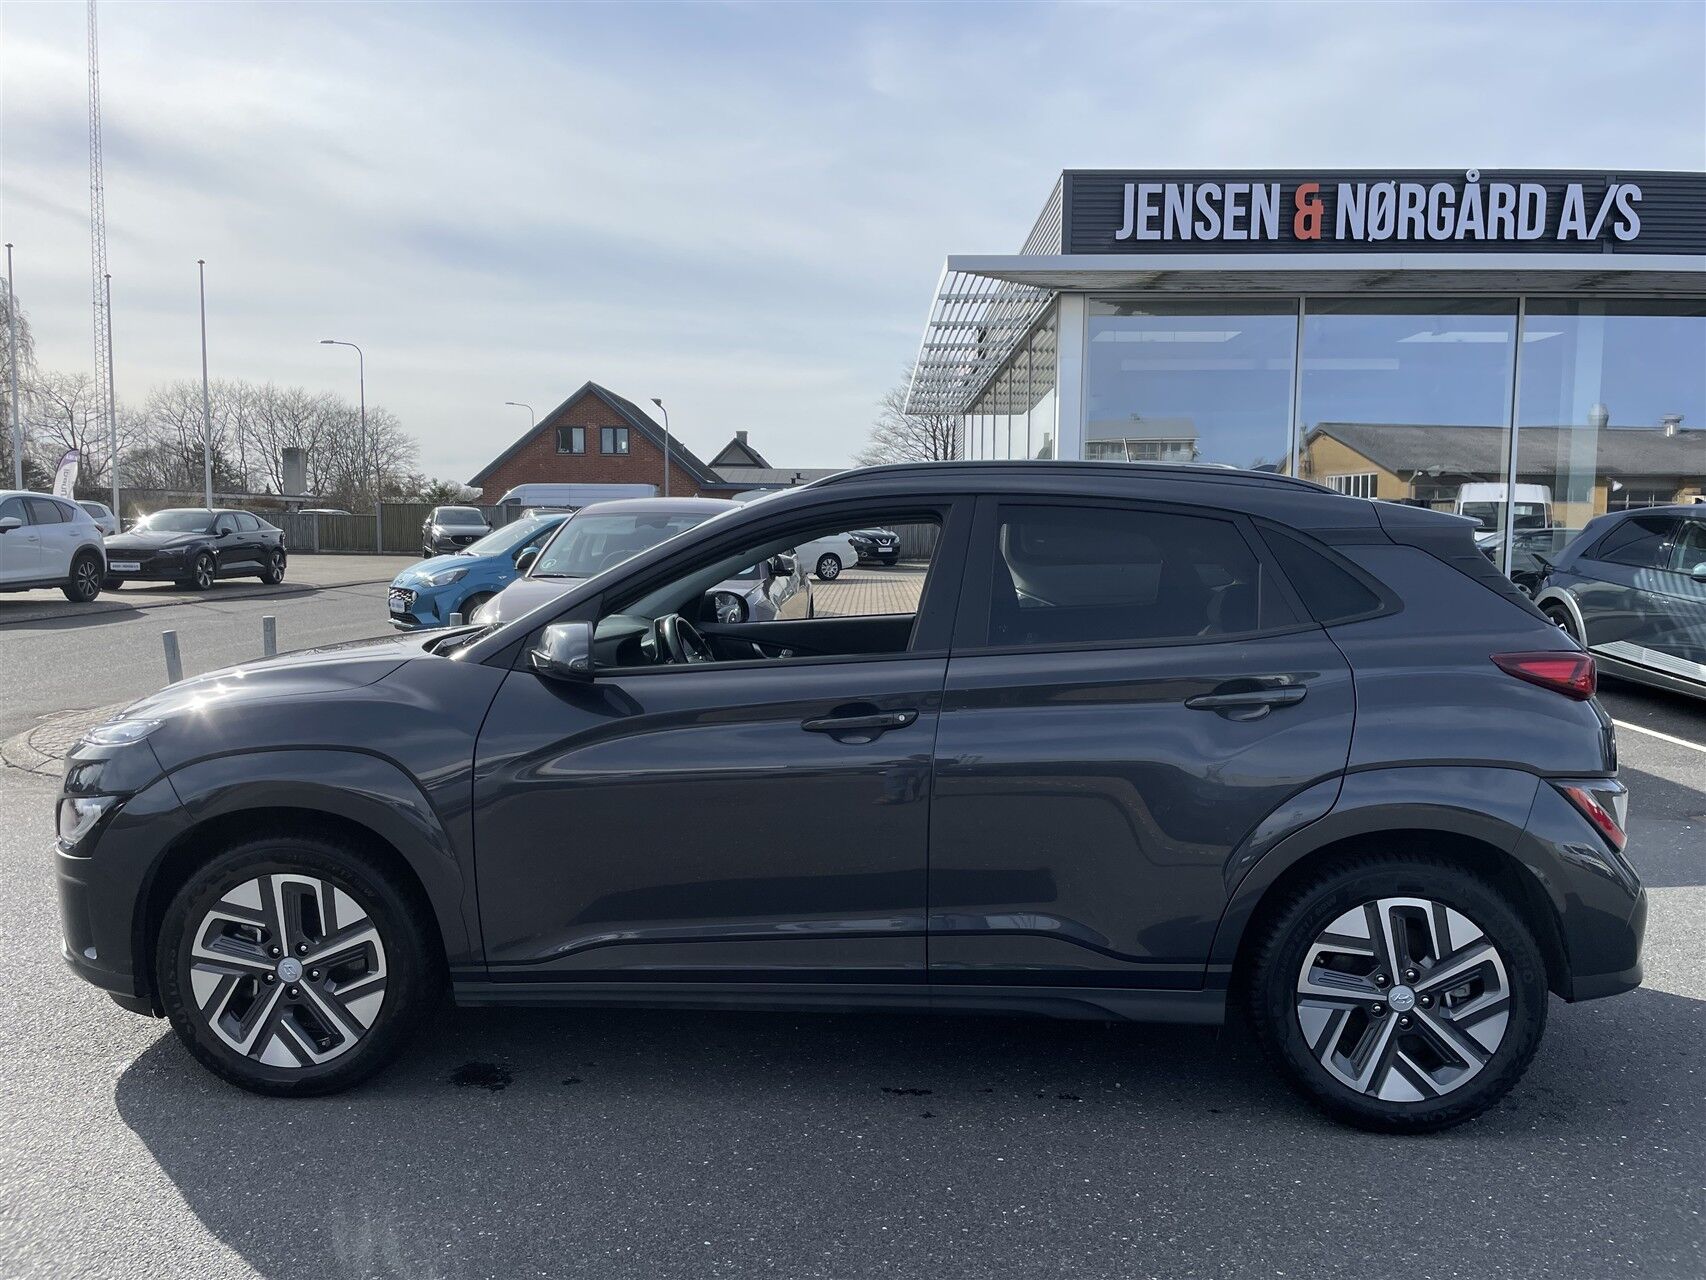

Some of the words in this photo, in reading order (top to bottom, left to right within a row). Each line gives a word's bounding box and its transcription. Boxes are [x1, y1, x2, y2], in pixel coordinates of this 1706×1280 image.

[1115, 183, 1281, 241] JENSEN
[1295, 183, 1324, 241] &
[1336, 169, 1547, 242] NØRGÅRD
[1557, 183, 1643, 241] A/S
